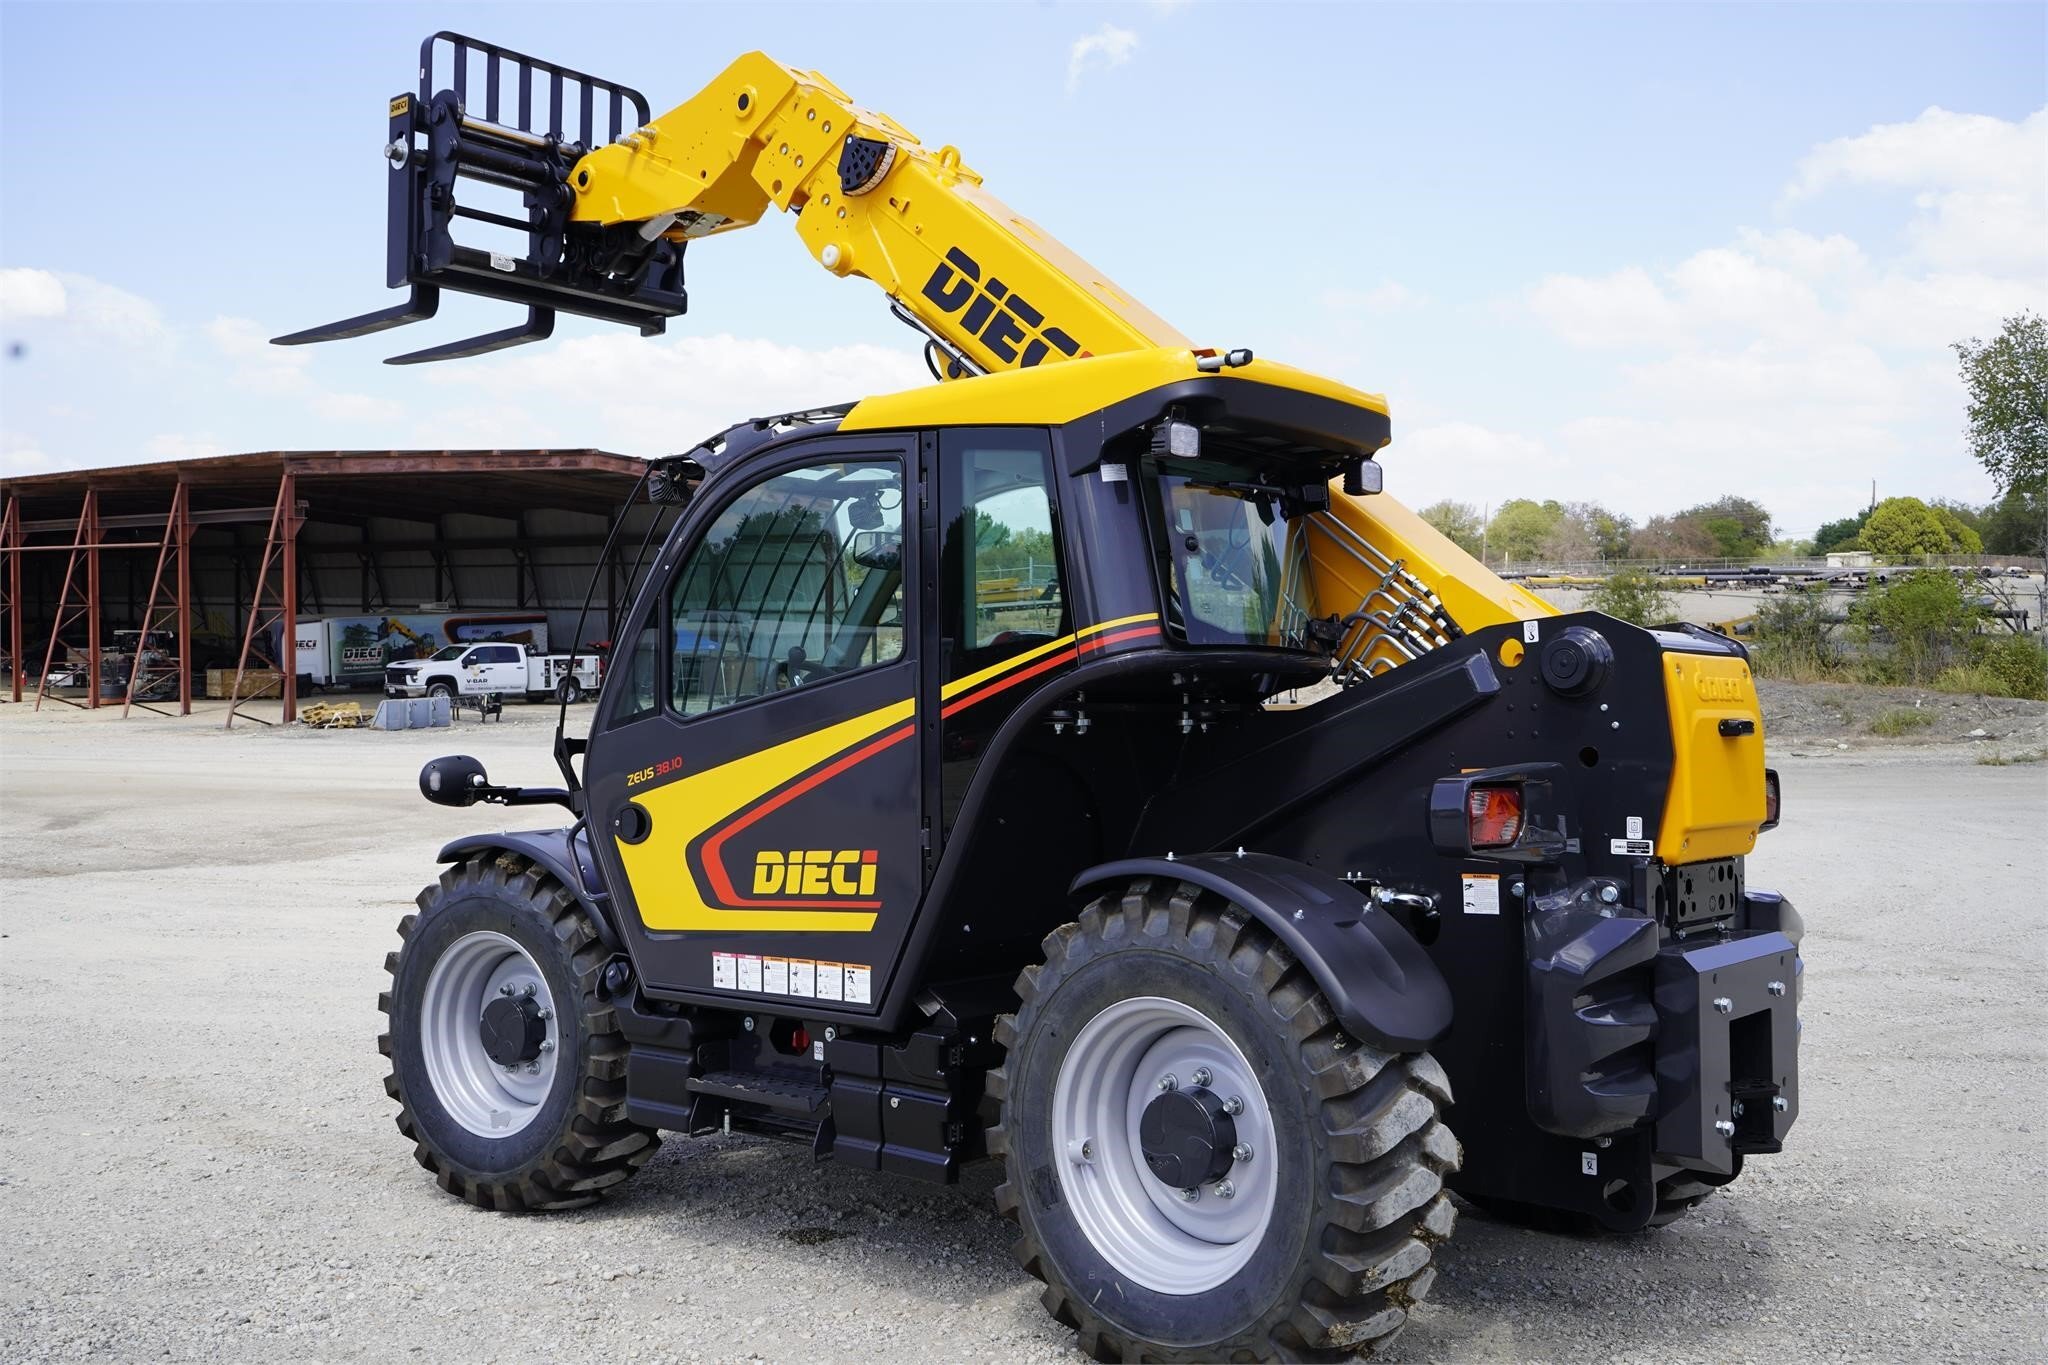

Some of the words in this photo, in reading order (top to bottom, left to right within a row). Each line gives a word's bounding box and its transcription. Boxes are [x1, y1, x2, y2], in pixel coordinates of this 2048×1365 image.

[921, 246, 1094, 369] DIEC
[344, 648, 383, 659] DIECI
[627, 766, 655, 787] ZEUS
[656, 756, 683, 776] 38.10
[753, 850, 878, 895] DIECI
